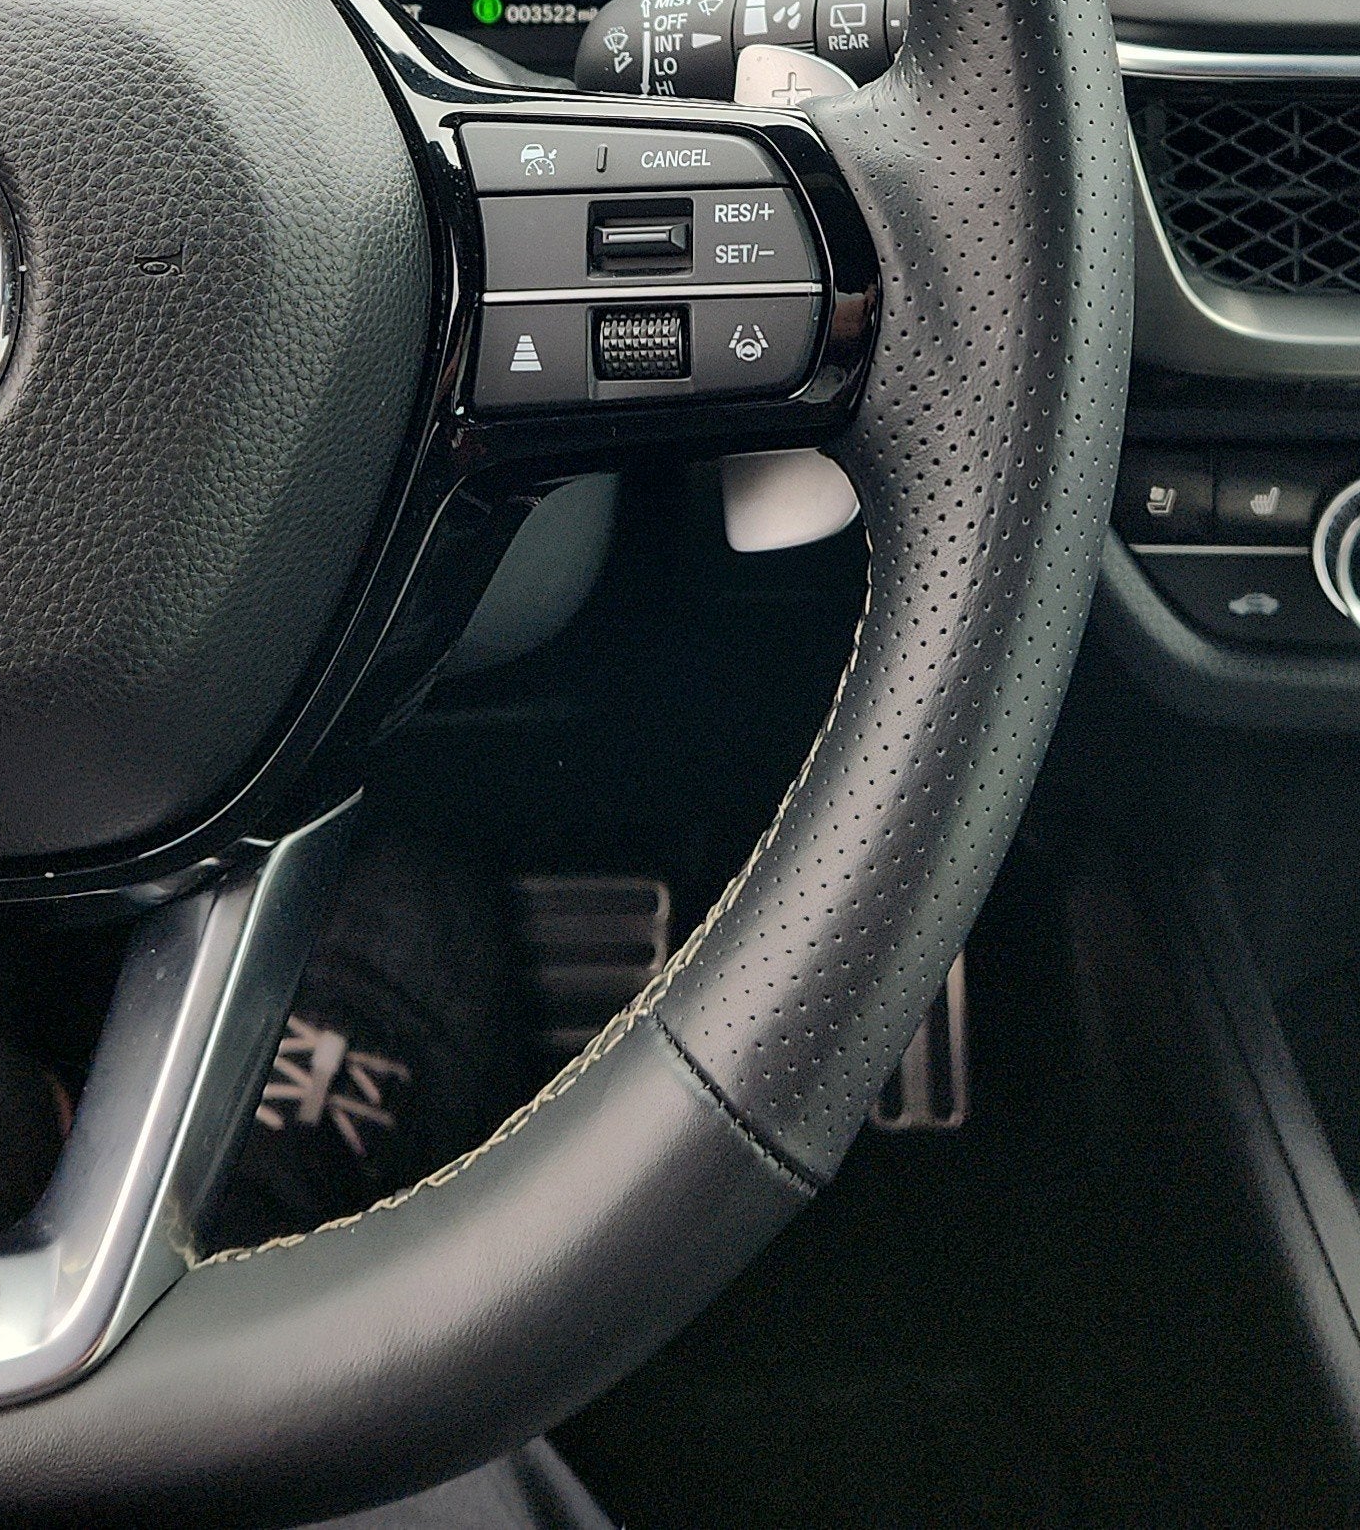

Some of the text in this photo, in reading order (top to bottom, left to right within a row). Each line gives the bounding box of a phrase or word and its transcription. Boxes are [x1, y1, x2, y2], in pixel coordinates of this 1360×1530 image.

[506, 4, 576, 24] 003522
[654, 13, 688, 32] OFF
[654, 33, 683, 53] INT
[828, 33, 870, 50] REAR
[654, 57, 678, 76] LO
[655, 81, 676, 97] HI
[640, 149, 712, 169] CANCEL
